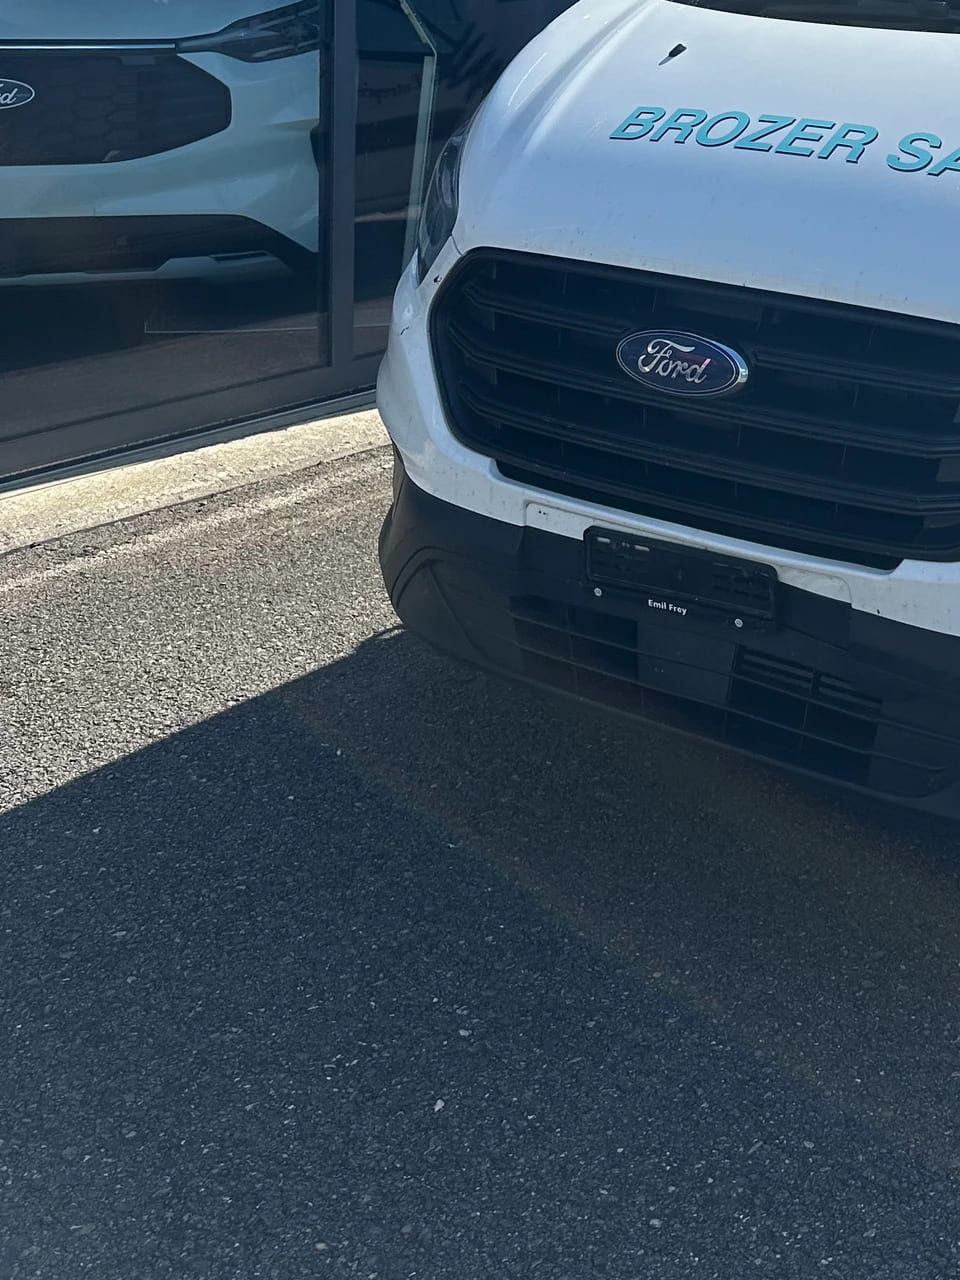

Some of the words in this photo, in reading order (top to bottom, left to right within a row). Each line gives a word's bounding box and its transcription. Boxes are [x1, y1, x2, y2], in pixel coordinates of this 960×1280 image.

[609, 106, 879, 163] BROZER
[638, 338, 711, 383] Ford
[648, 599, 667, 610] Emil
[669, 603, 687, 616] Frey
